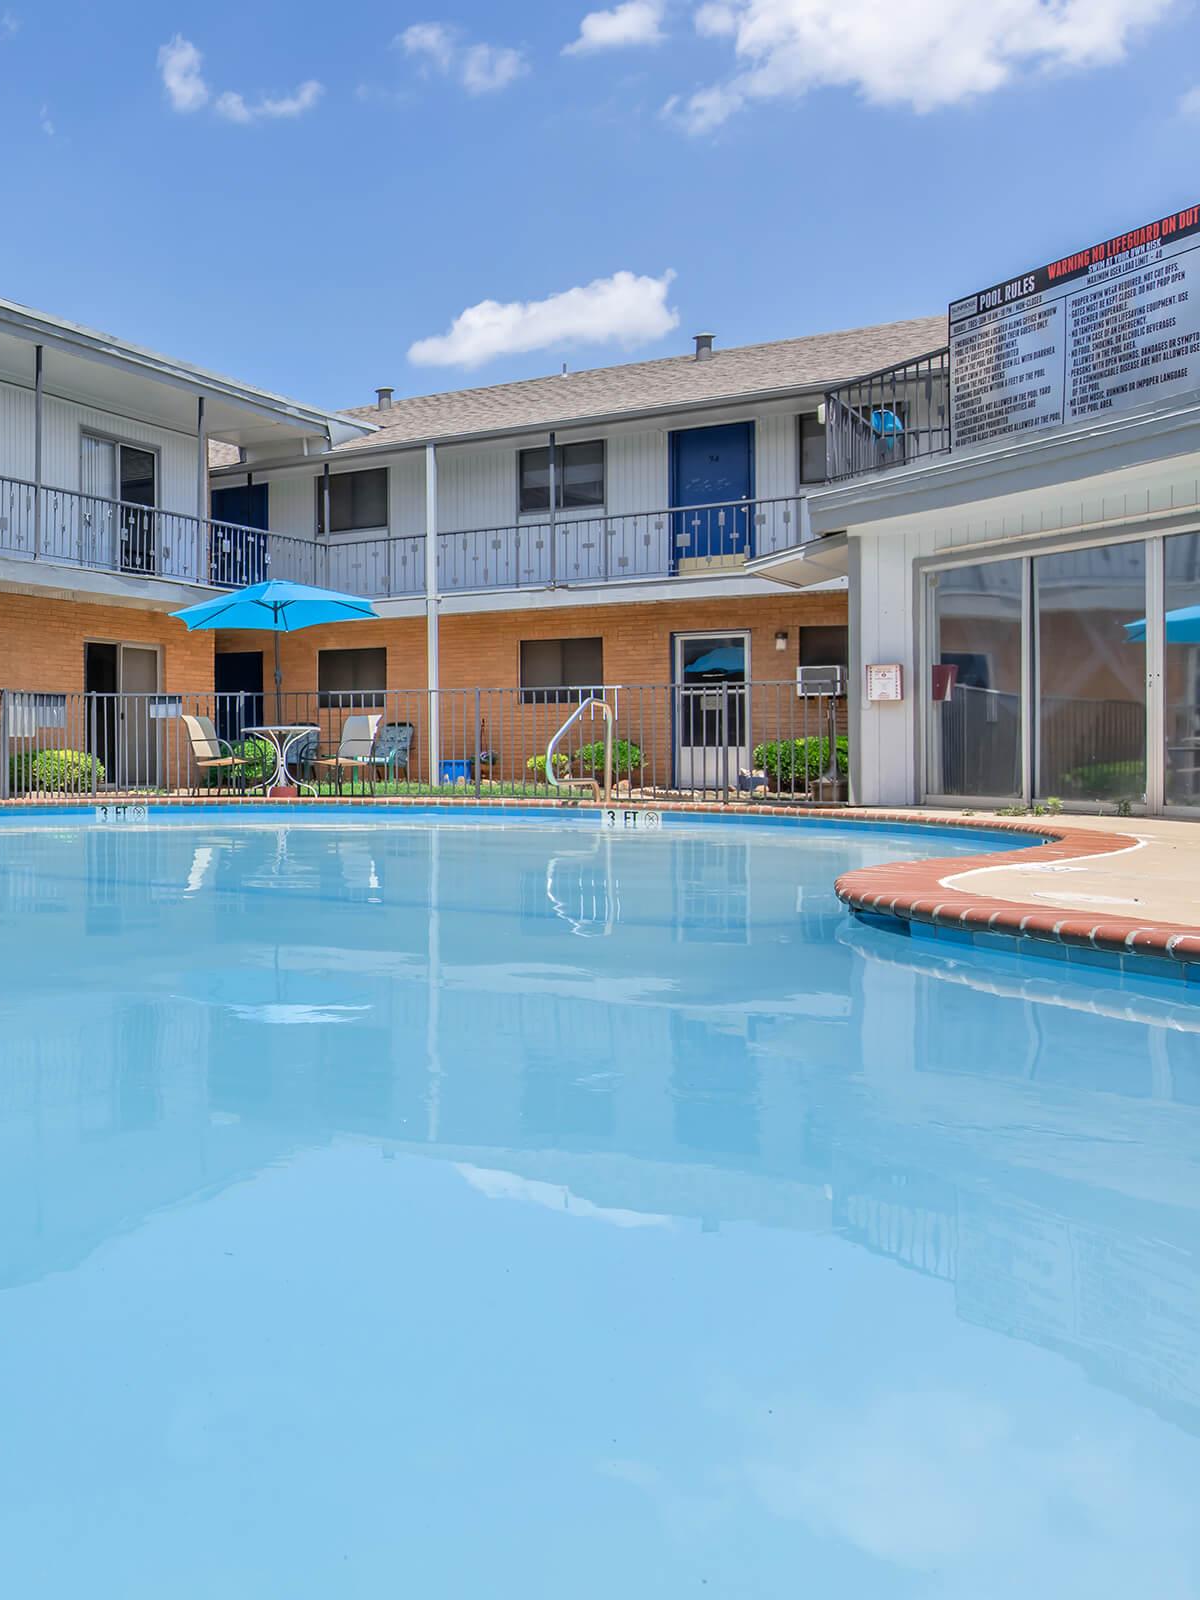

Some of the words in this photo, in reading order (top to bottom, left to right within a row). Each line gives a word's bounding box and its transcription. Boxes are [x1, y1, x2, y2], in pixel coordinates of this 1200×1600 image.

[1048, 251, 1089, 281] WARNING
[1092, 245, 1104, 264] NO
[1107, 224, 1159, 258] LIFEGUARD
[1162, 217, 1176, 237] ON
[1180, 207, 1200, 231] DUT
[1088, 259, 1104, 274] SWIM
[1106, 256, 1113, 267] AT
[1115, 250, 1129, 264] YOUR
[1131, 244, 1145, 258] OWN
[1147, 238, 1161, 252] RISK
[1072, 295, 1088, 308] PROPER
[1089, 289, 1103, 302] SWIM
[1104, 284, 1117, 297] WEAR
[1144, 271, 1153, 283] NOT
[1154, 267, 1164, 279] CUT
[1087, 269, 1108, 286] MAXIMUM
[1110, 265, 1121, 277] USER
[1123, 260, 1134, 272] LOAD
[1135, 254, 1148, 268] LIMIT
[980, 287, 1002, 311] POOL
[1005, 274, 1035, 302] RULES
[1072, 306, 1085, 318] GATES
[1086, 301, 1098, 313] MUST
[1100, 299, 1105, 308] BE
[1106, 294, 1117, 306] KEPT
[1139, 285, 1145, 295] DO
[1146, 281, 1155, 292] NOT
[1157, 276, 1170, 289] PROP
[1171, 271, 1185, 284] OPEN
[1072, 328, 1078, 338] NO
[1079, 319, 1104, 335] TAMPERING
[1105, 315, 1117, 327] WITH
[1119, 306, 1145, 322] LIFESAVING
[1178, 291, 1188, 303] USE
[1074, 318, 1079, 327] OR
[1081, 311, 1098, 325] RENDER
[1072, 348, 1077, 358] NO
[1115, 334, 1121, 344] OR
[1146, 317, 1176, 334] BEVERAGES
[1074, 336, 1085, 347] ONLY
[1086, 334, 1091, 343] IN
[1092, 330, 1103, 341] CASE
[1104, 327, 1110, 337] OF
[1111, 325, 1117, 335] AN
[1071, 364, 1091, 377] PERSONS
[1093, 360, 1104, 371] WITH
[1105, 356, 1116, 367] OPEN
[1141, 341, 1168, 357] BANDAGES
[1169, 338, 1176, 349] OR
[1073, 353, 1094, 367] ALLOWED
[1096, 351, 1100, 360] IN
[1102, 348, 1110, 358] THE
[1111, 344, 1122, 355] POOL
[1073, 377, 1079, 387] OF
[1080, 376, 1082, 385] A
[1083, 365, 1119, 384] COMMUNICABLE
[1120, 360, 1139, 373] DISEASE
[1141, 356, 1150, 367] ARE
[1152, 353, 1162, 364] NOT
[1163, 345, 1188, 361] ALLOWED
[1070, 398, 1076, 407] NO
[1077, 395, 1088, 405] LOUD
[1106, 384, 1127, 397] RUNNING
[1129, 382, 1135, 391] OR
[1161, 367, 1188, 383] LANGUAGE
[1072, 388, 1078, 397] OF
[1079, 385, 1087, 395] THE
[1072, 408, 1077, 417] IN
[1078, 405, 1086, 415] THE
[1088, 402, 1098, 412] POOL
[607, 810, 616, 822] 3
[624, 811, 639, 823] FT
